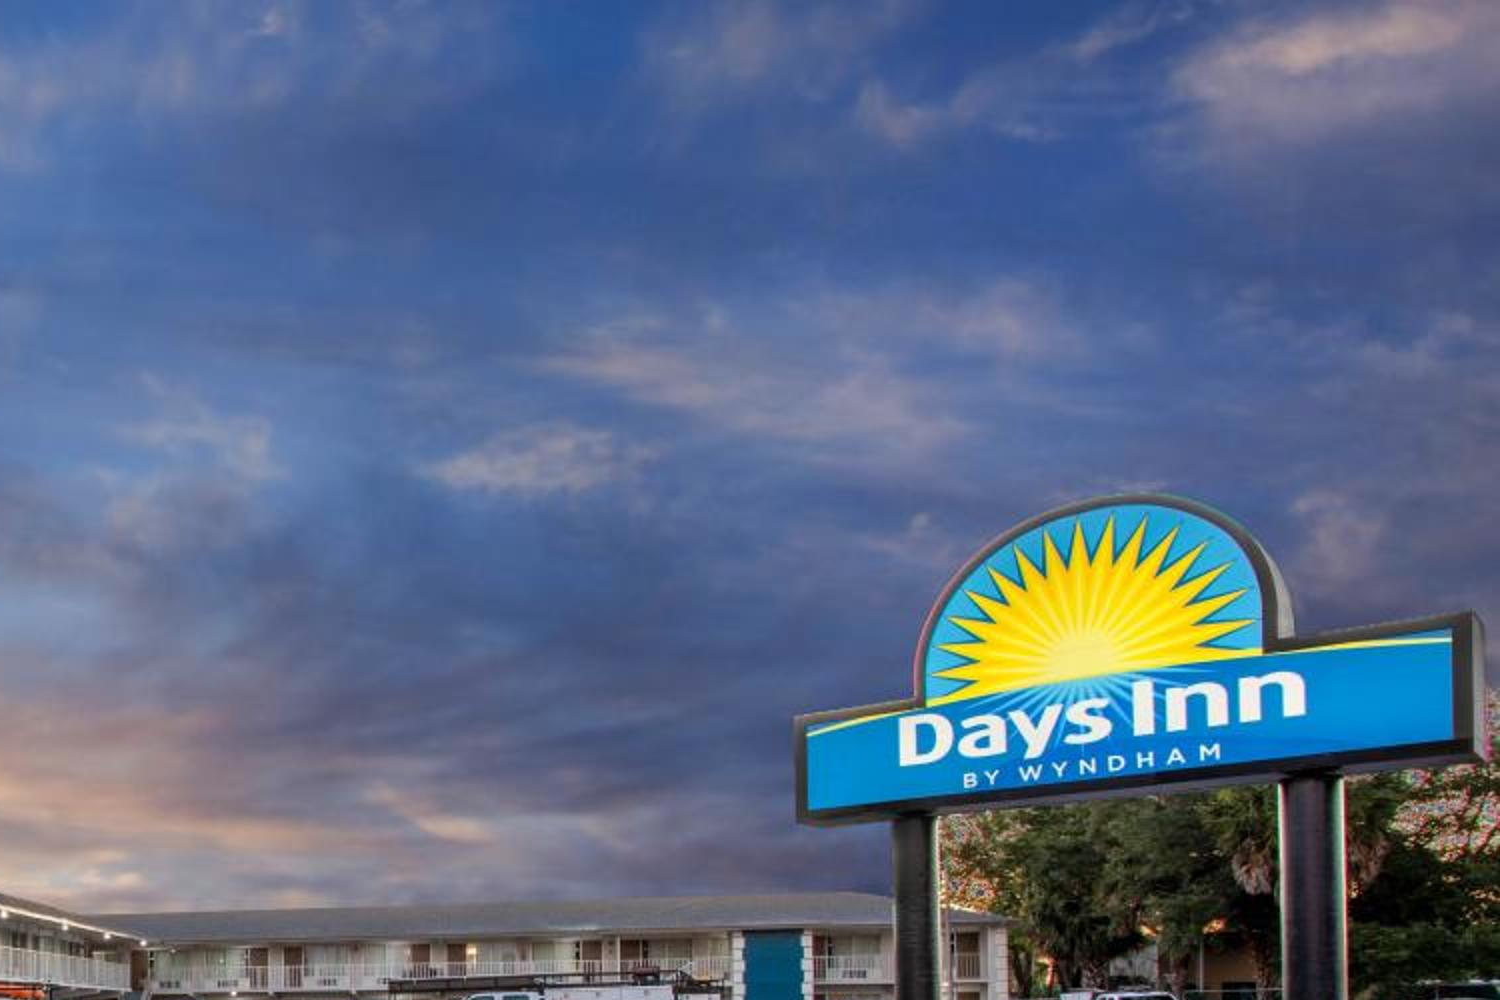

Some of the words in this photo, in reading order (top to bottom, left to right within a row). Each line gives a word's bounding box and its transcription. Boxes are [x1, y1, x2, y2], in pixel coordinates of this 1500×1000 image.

[898, 697, 1113, 767] Days
[1132, 670, 1307, 736] Inn
[963, 771, 999, 789] BY
[1019, 742, 1223, 782] WYNDHAM
